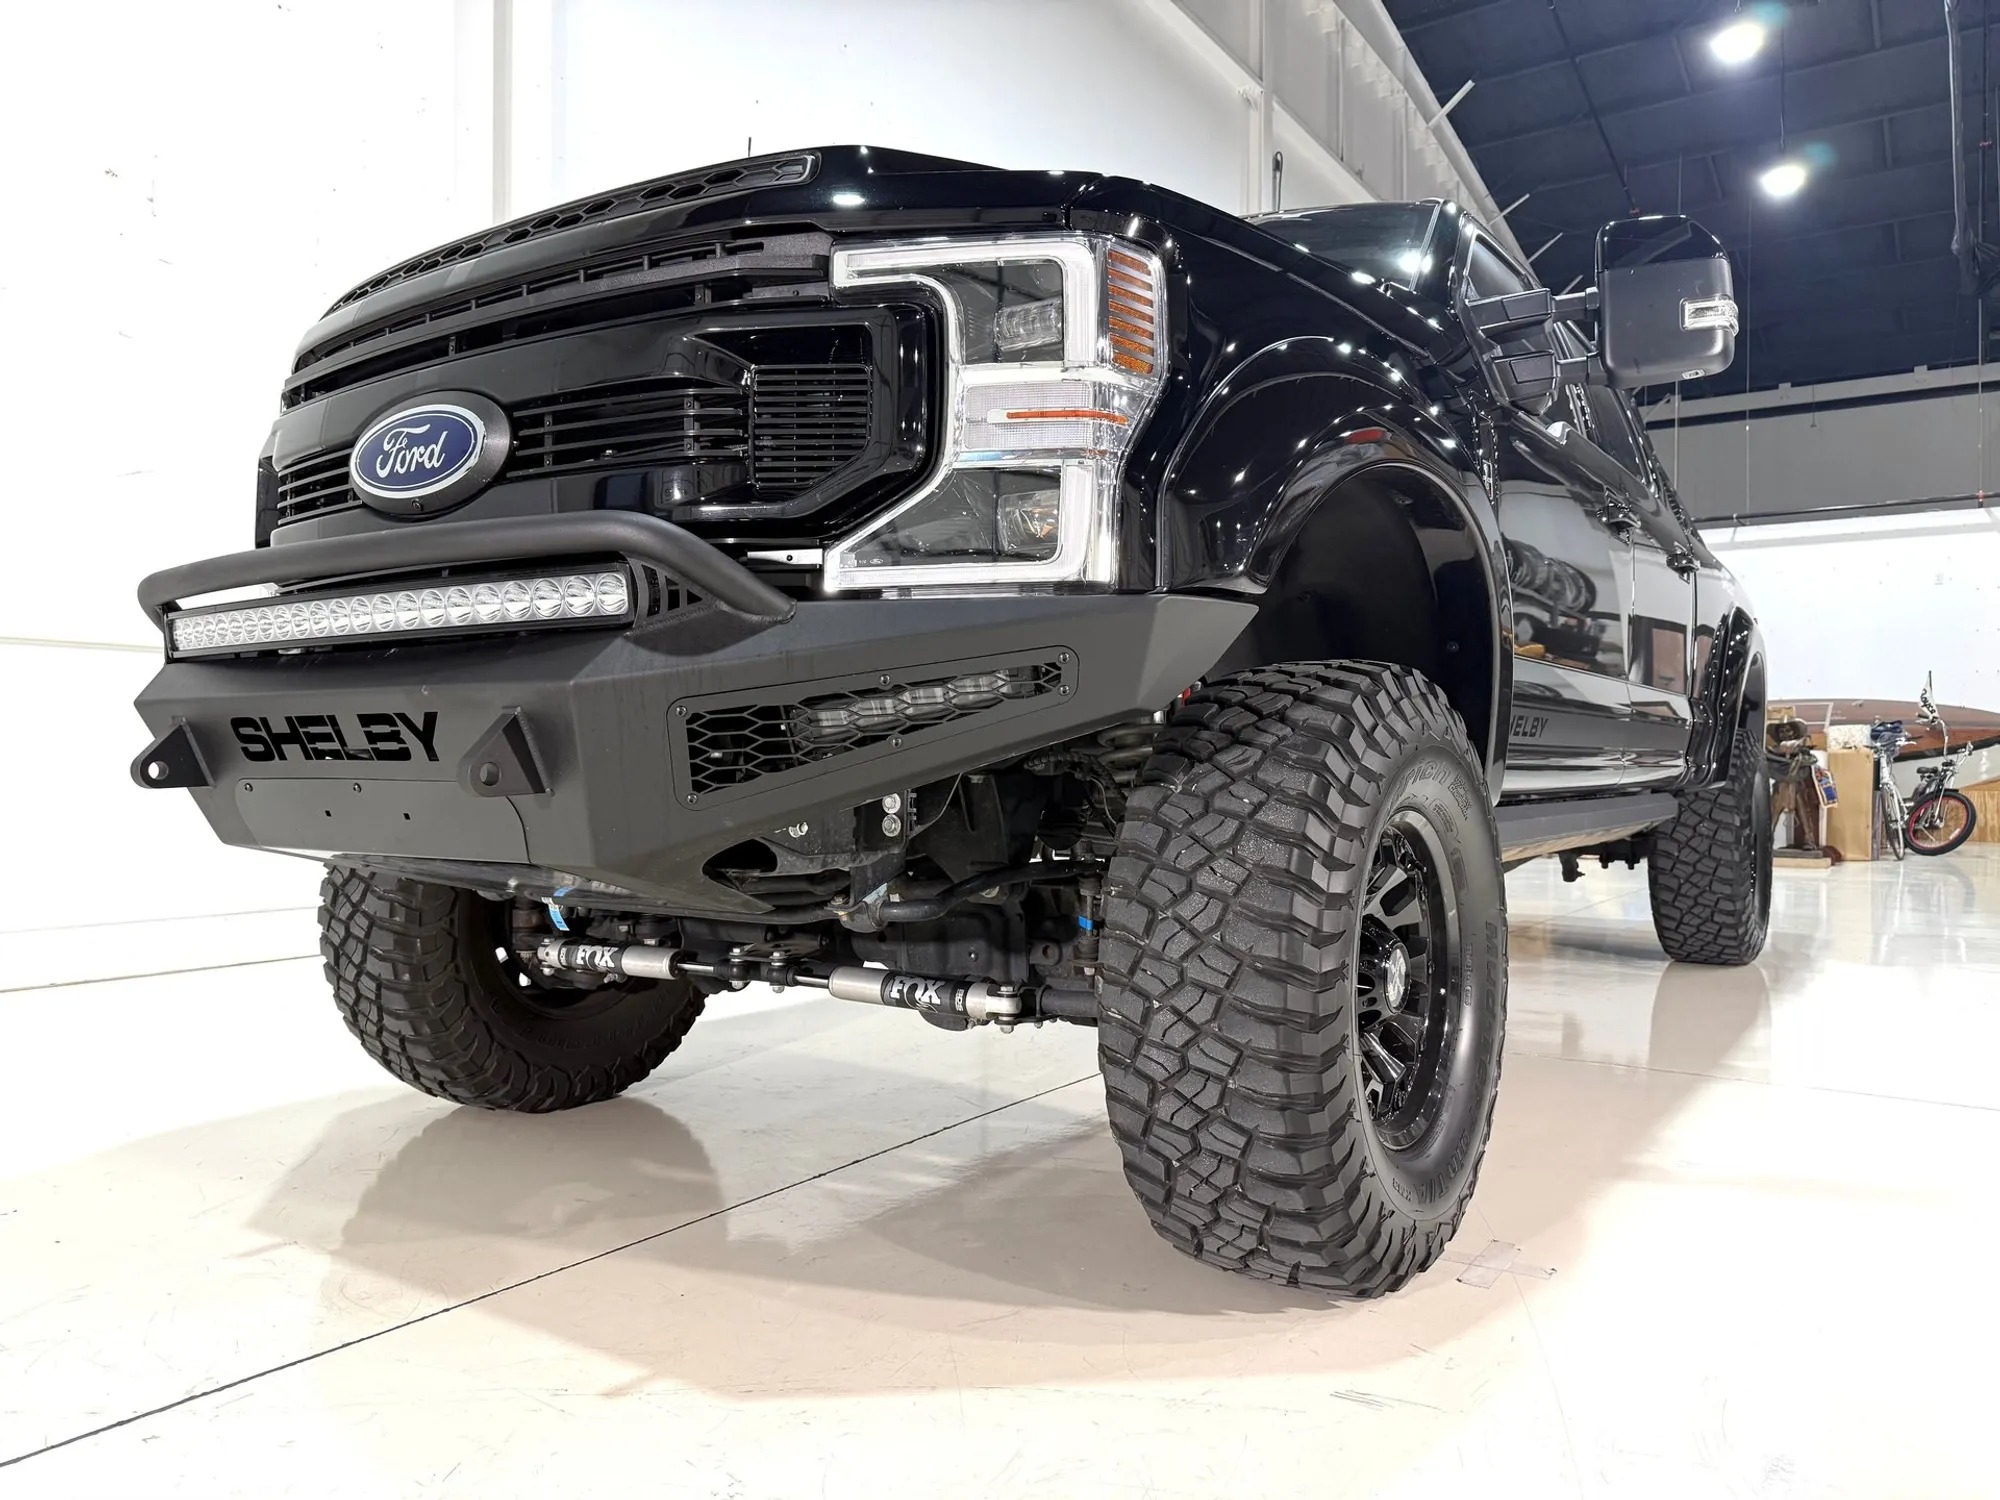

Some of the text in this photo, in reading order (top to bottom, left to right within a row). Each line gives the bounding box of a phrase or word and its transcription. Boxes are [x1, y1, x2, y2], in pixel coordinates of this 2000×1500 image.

[376, 424, 448, 478] Ford
[230, 711, 440, 762] SHELBY
[576, 945, 618, 969] FOX
[889, 975, 946, 1006] FOX
